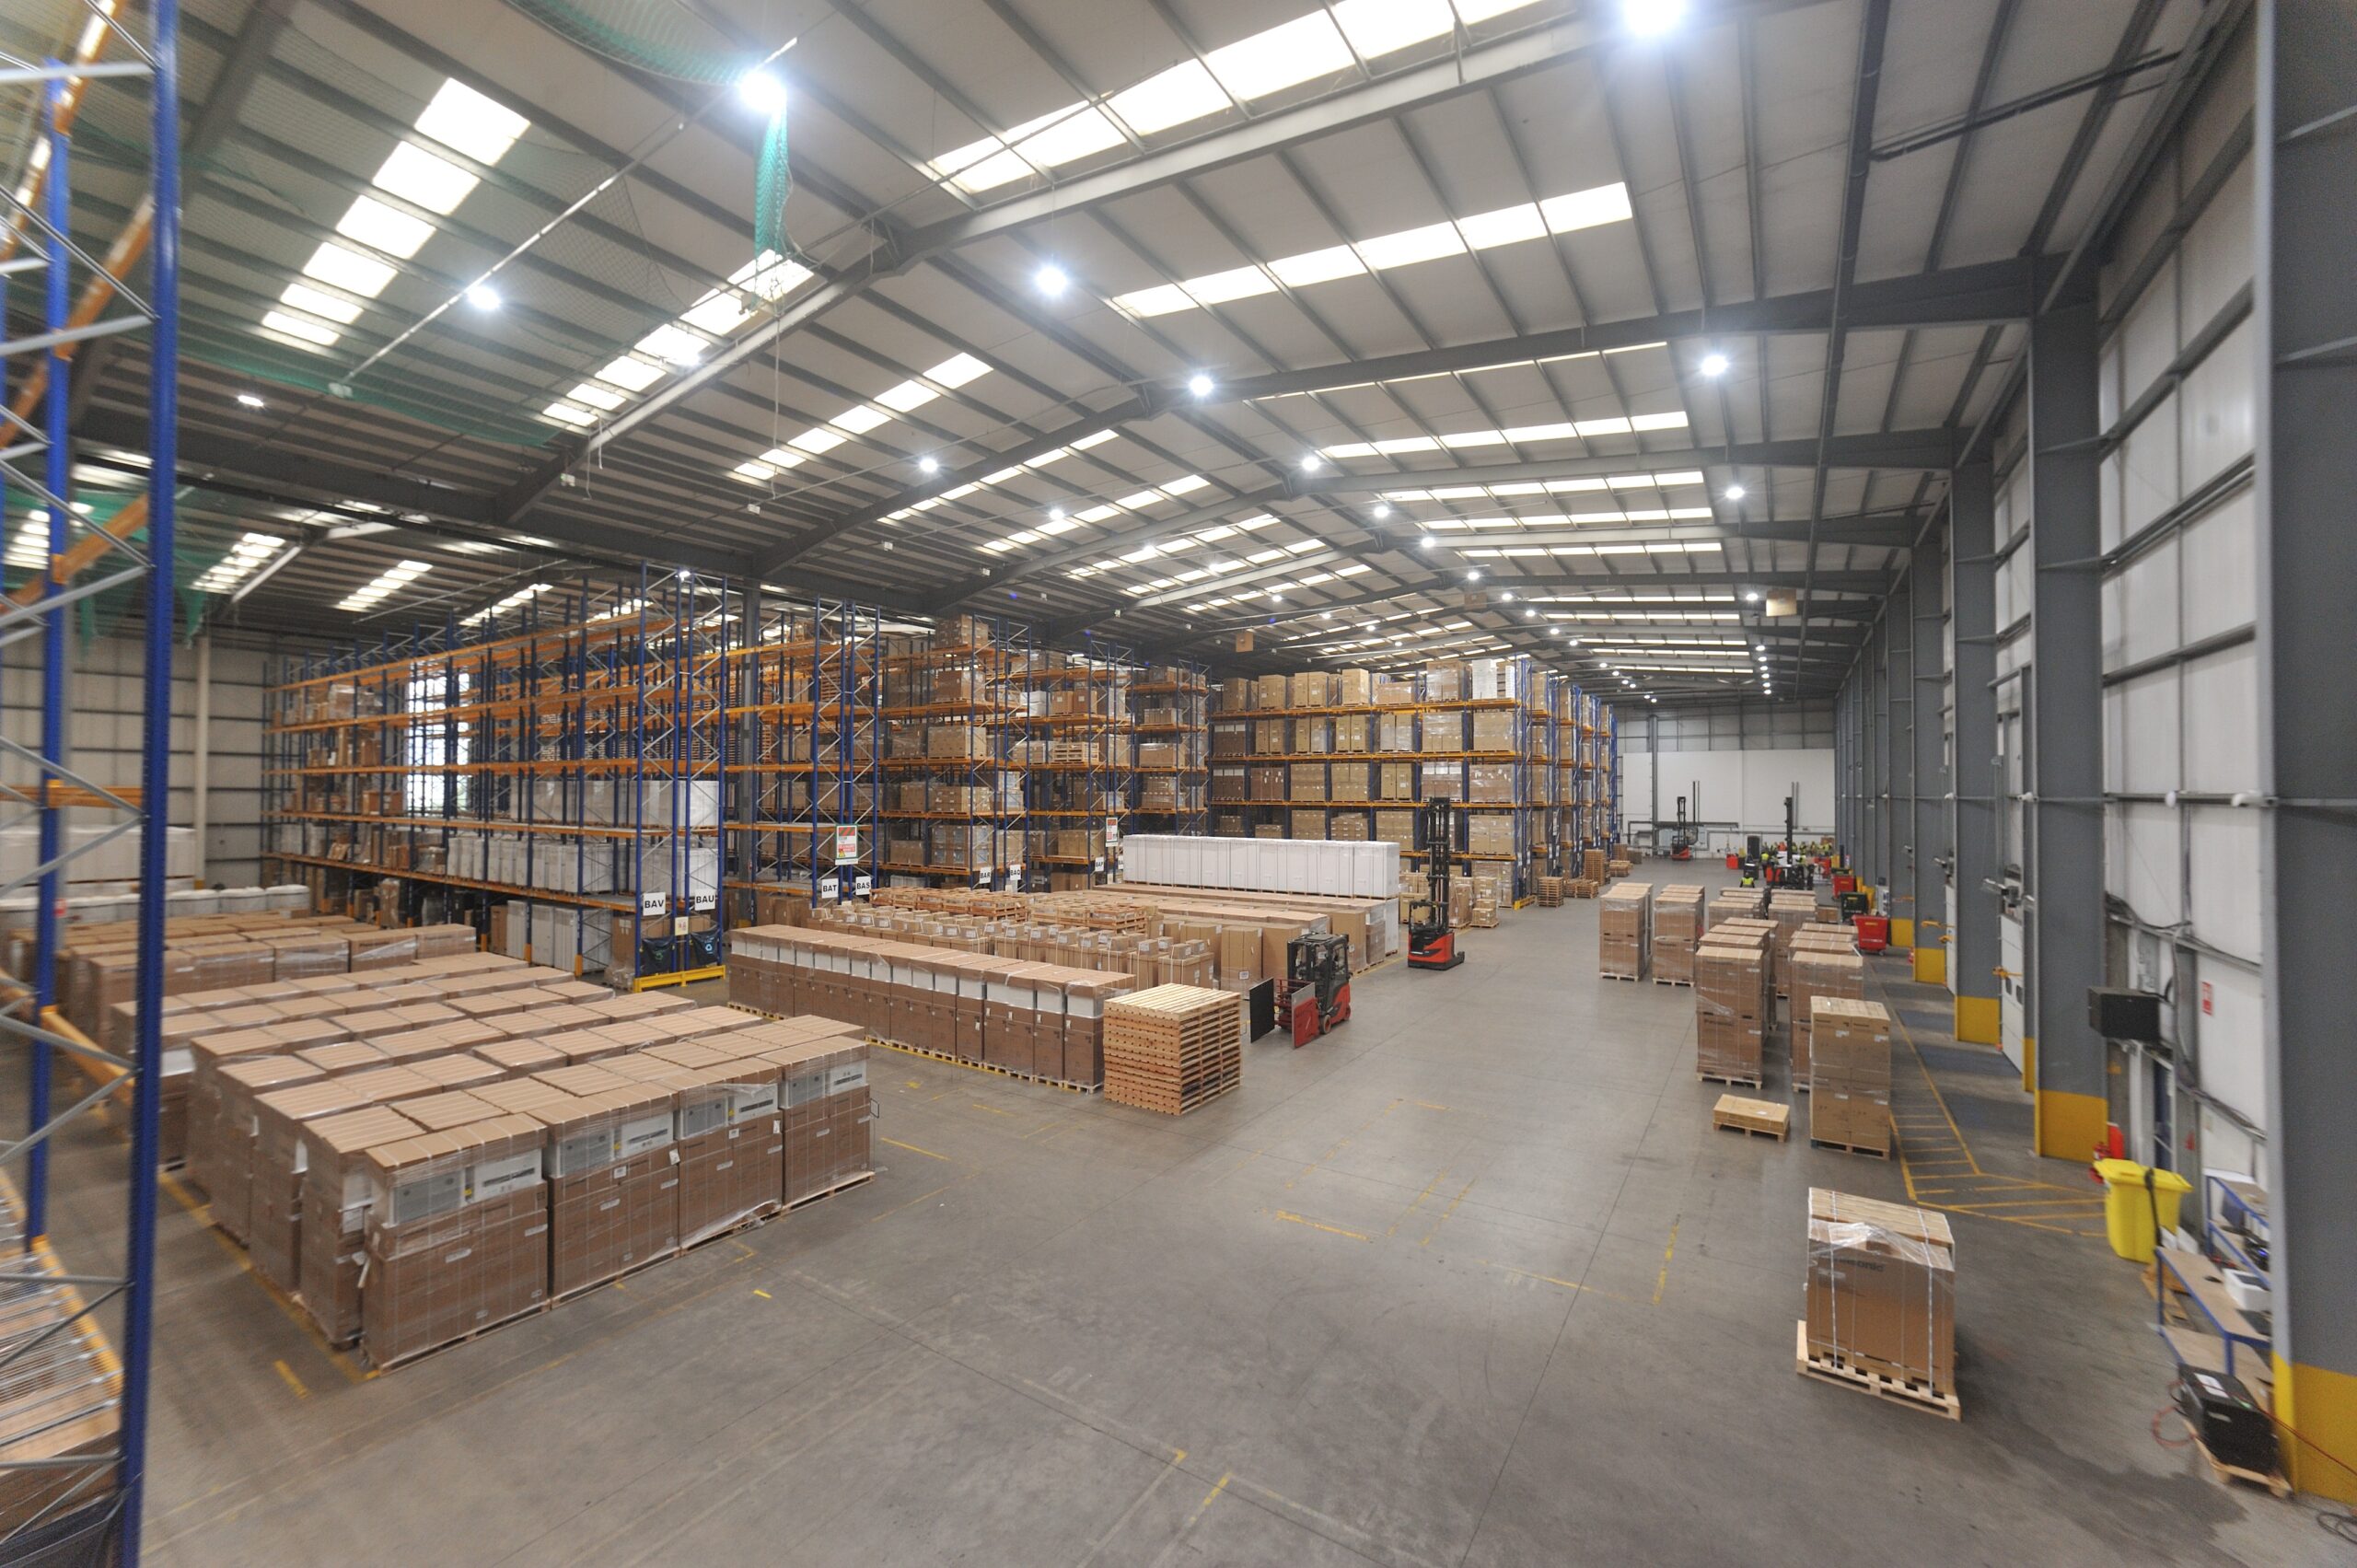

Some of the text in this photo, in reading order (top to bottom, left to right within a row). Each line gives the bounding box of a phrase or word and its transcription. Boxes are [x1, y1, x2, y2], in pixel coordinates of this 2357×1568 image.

[856, 882, 870, 890] BAS
[696, 895, 714, 903] BAU
[644, 900, 664, 909] BAV
